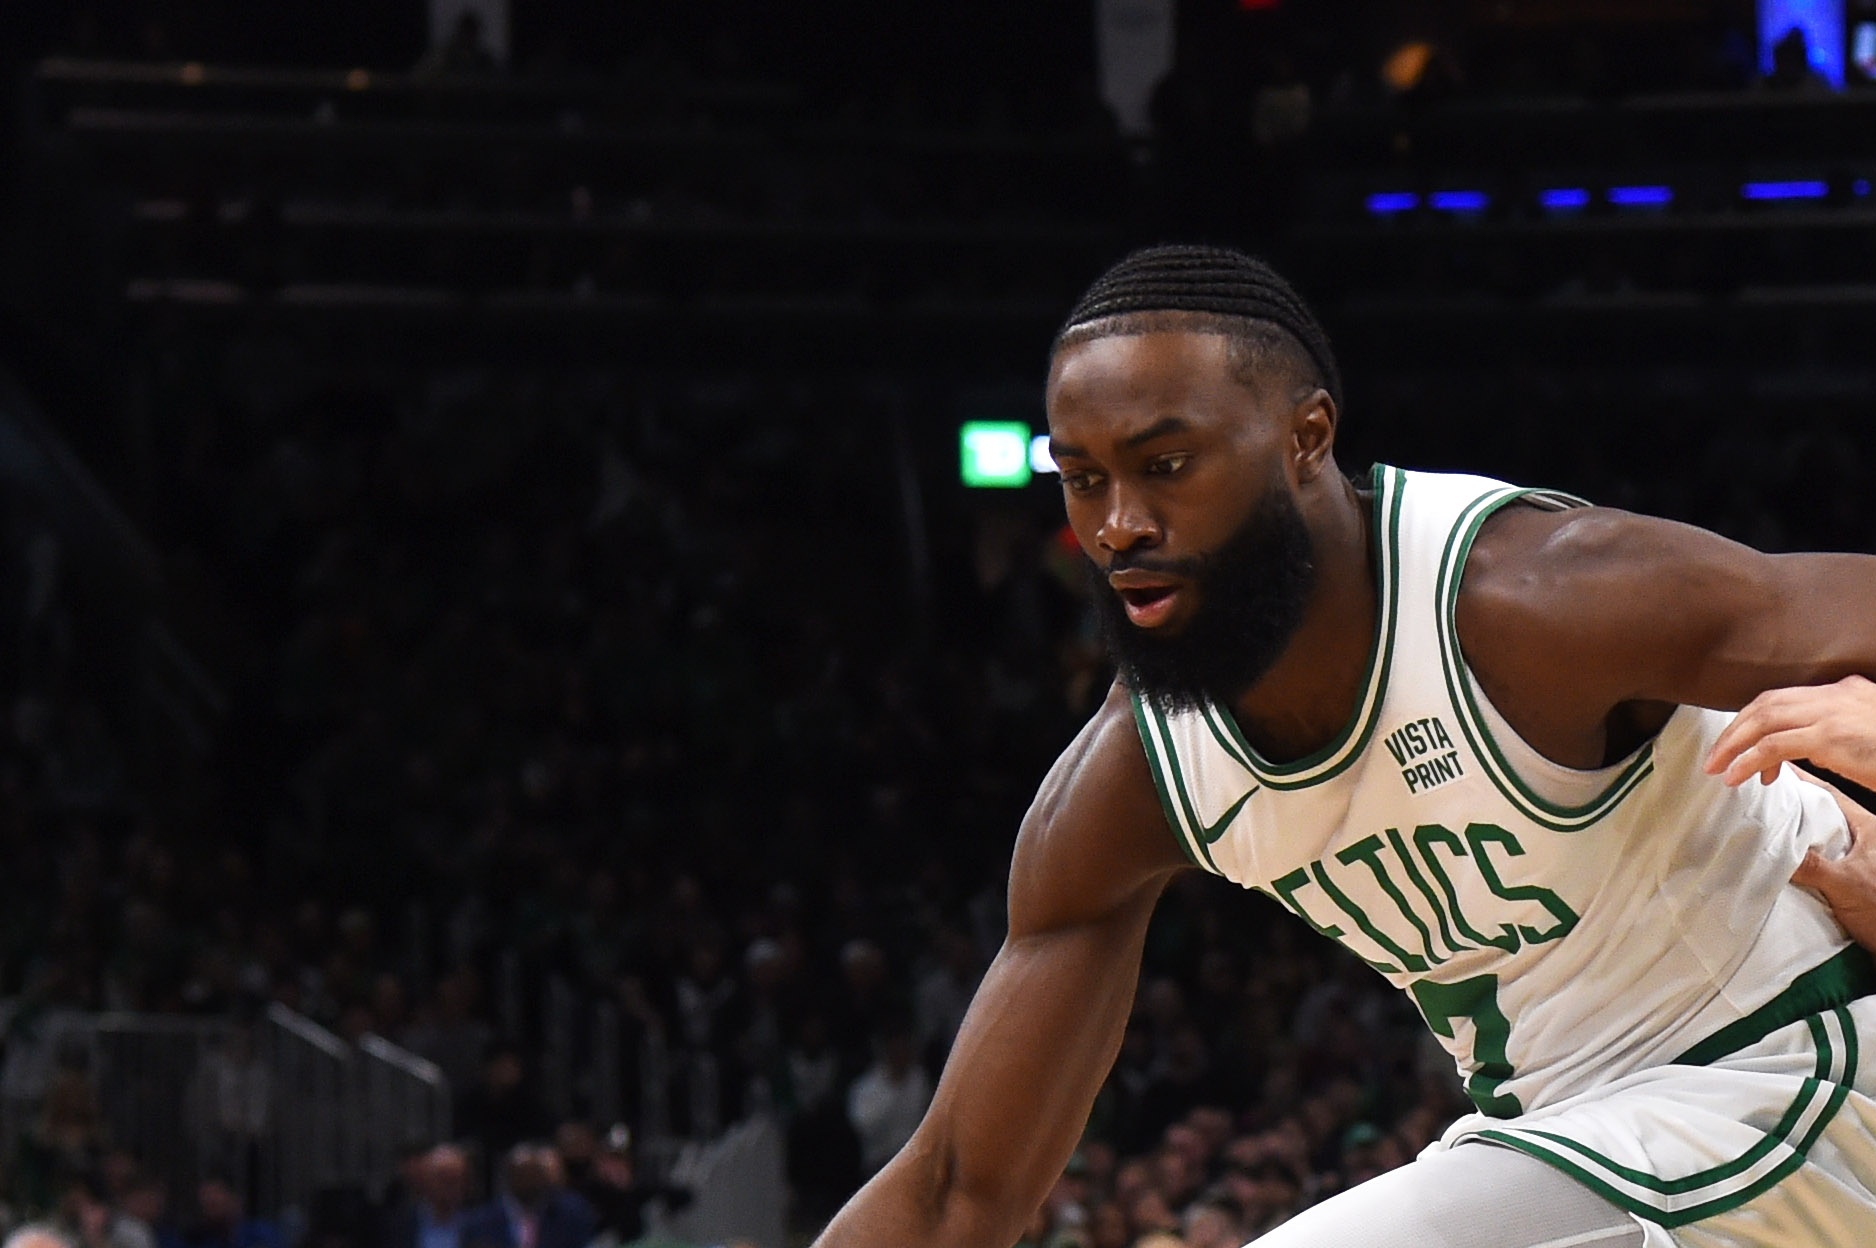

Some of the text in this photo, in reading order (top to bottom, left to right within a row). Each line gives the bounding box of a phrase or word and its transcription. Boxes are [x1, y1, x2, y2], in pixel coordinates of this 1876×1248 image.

[1384, 717, 1454, 767] VISTA
[1402, 750, 1463, 794] PRINT
[1270, 822, 1581, 974] ELTICS
[1409, 973, 1524, 1120] 7
